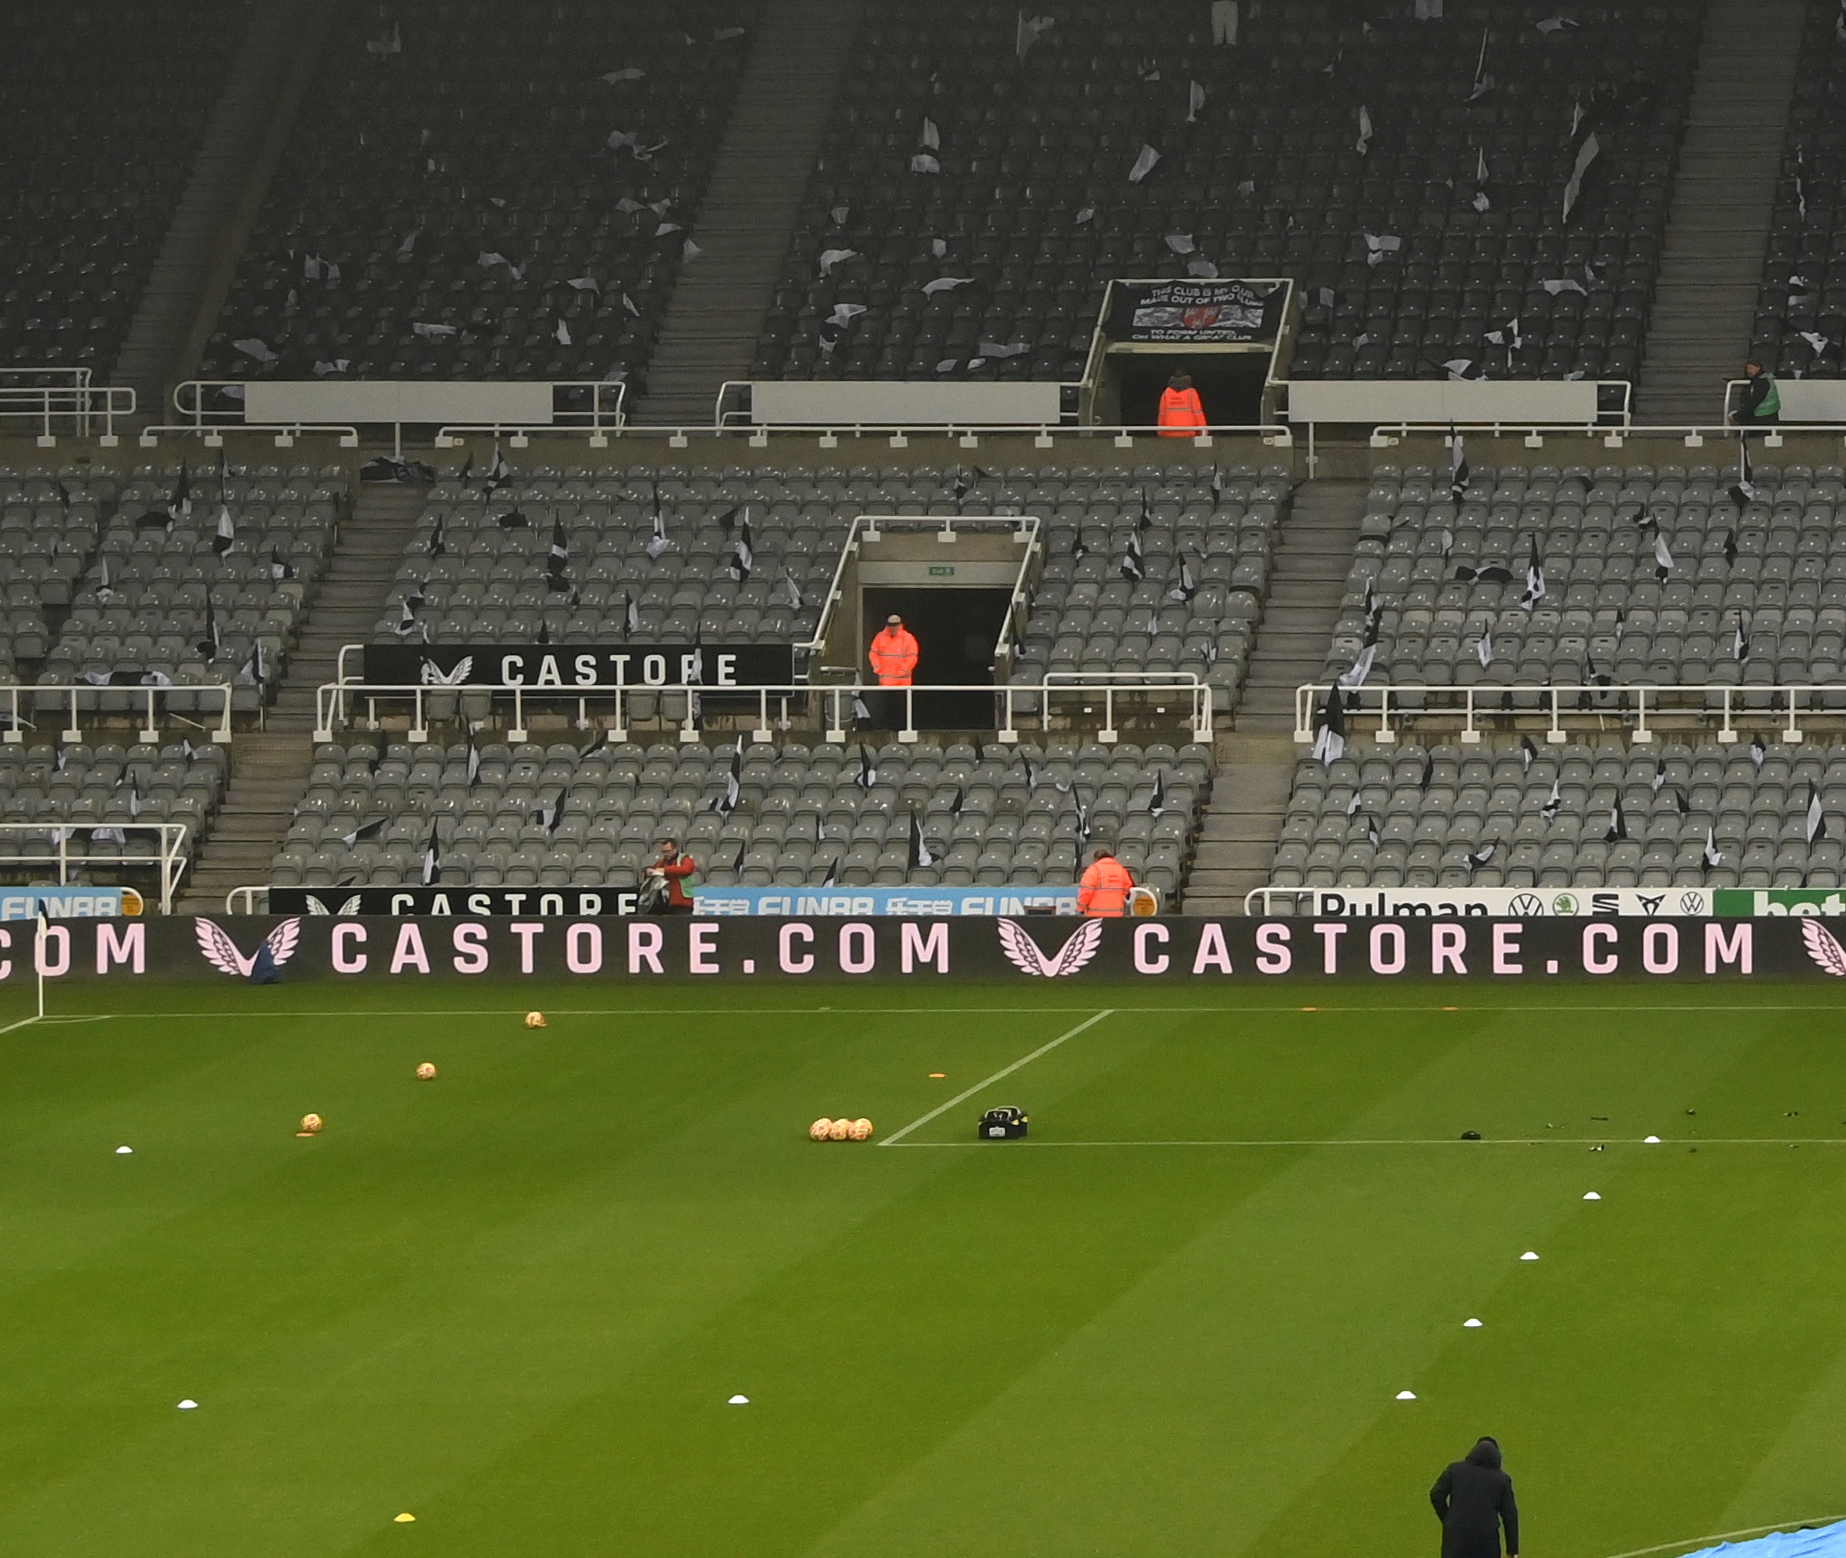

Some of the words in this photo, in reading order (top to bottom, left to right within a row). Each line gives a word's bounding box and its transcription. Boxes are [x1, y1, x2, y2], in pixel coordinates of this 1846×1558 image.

[1171, 295, 1193, 304] OUT
[1174, 286, 1200, 297] CLUB
[391, 894, 638, 915] CASTORE
[332, 923, 949, 974] CASTORE.COM
[1135, 923, 1753, 974] CASTORE.COM
